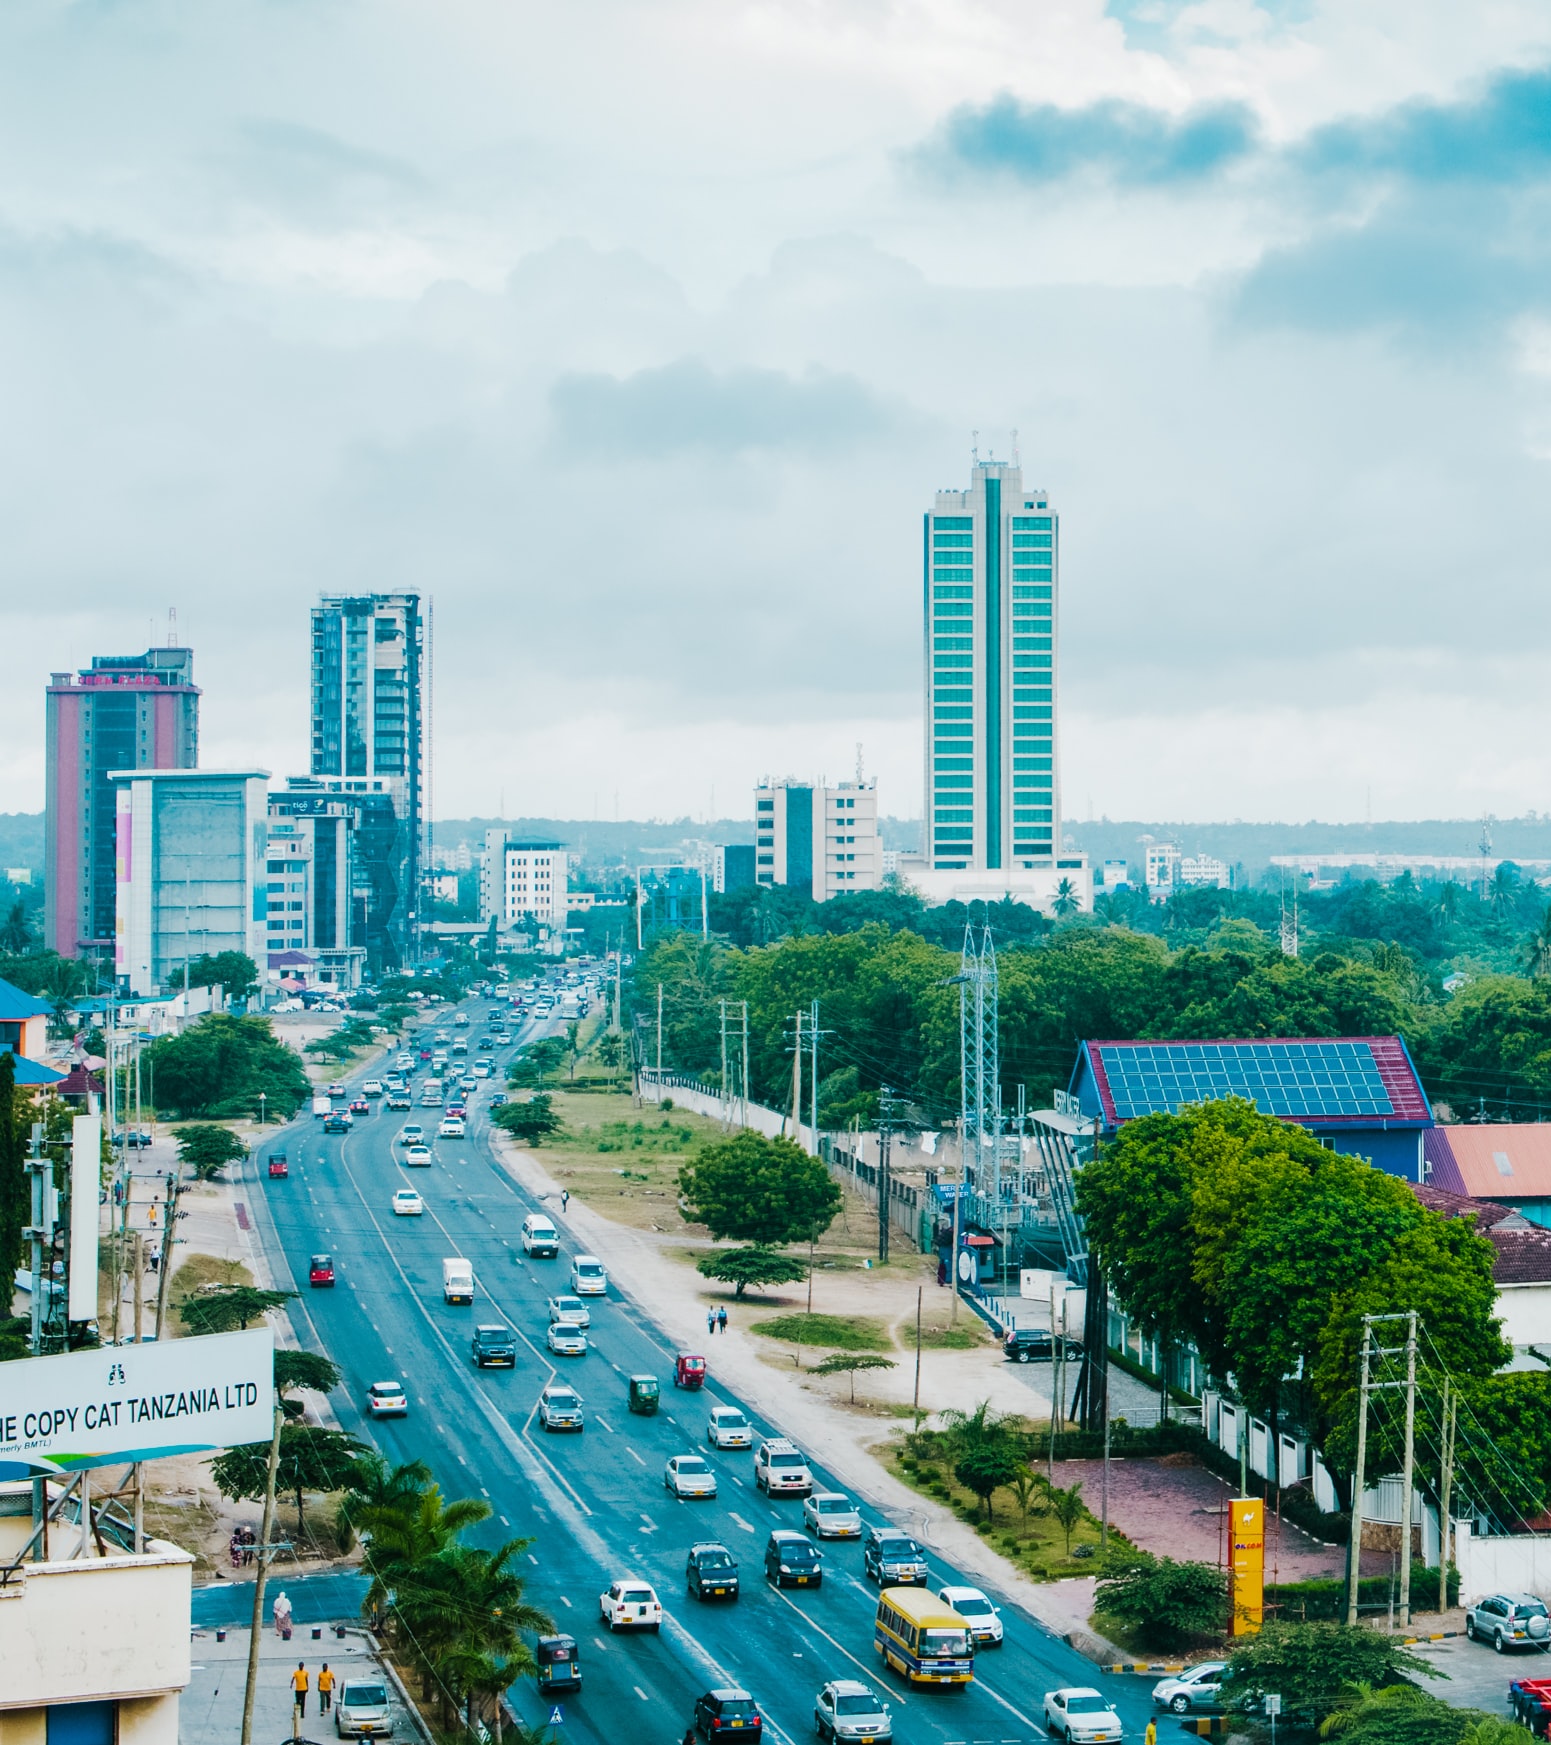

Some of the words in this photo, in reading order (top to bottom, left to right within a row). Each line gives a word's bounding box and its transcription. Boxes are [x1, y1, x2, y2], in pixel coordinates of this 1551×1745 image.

[118, 675, 161, 685] PLAZA
[292, 801, 308, 812] tigo
[24, 1408, 78, 1439] COPY
[85, 1401, 122, 1429] CAT
[127, 1387, 220, 1423] TANZANIA
[226, 1382, 258, 1409] LTD
[24, 1439, 52, 1449] BMTL)
